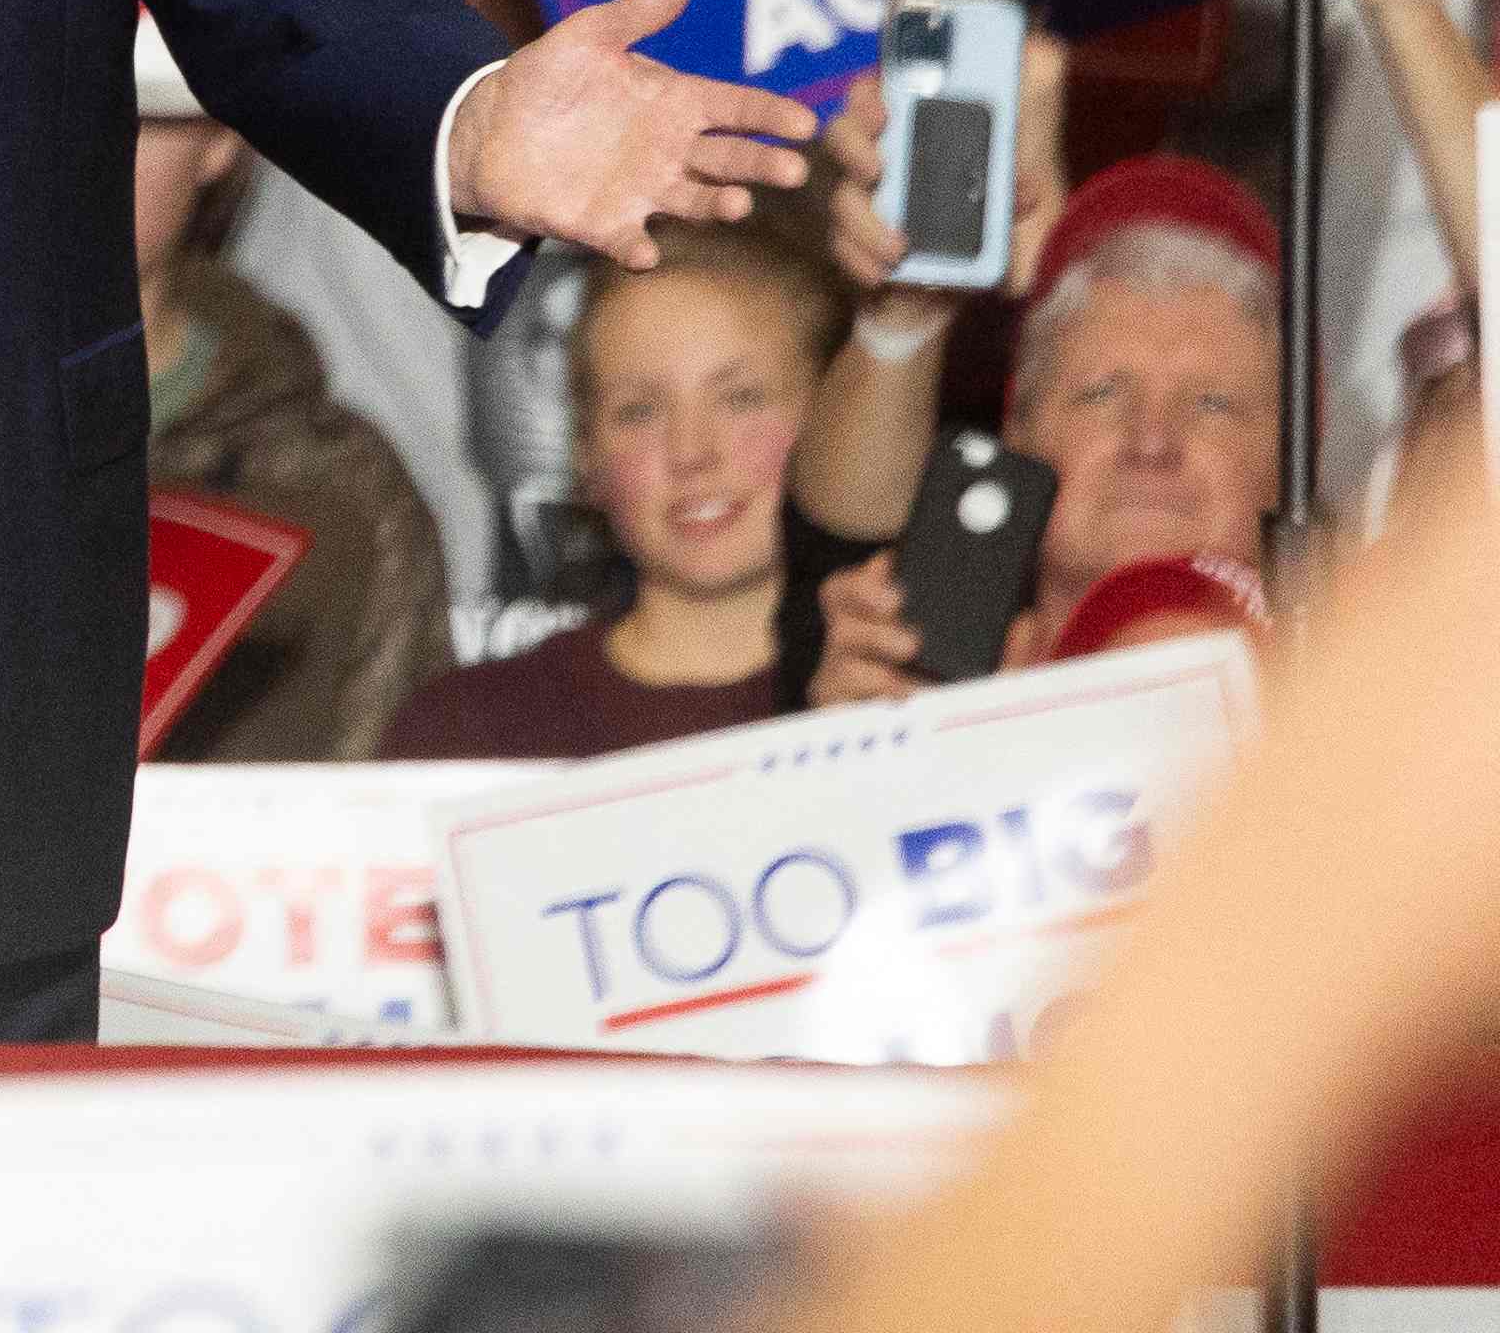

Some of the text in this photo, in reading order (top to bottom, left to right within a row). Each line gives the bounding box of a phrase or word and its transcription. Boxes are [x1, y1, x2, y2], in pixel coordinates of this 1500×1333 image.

[140, 861, 442, 974] OTE
[541, 786, 1154, 1010] TOO BIG
